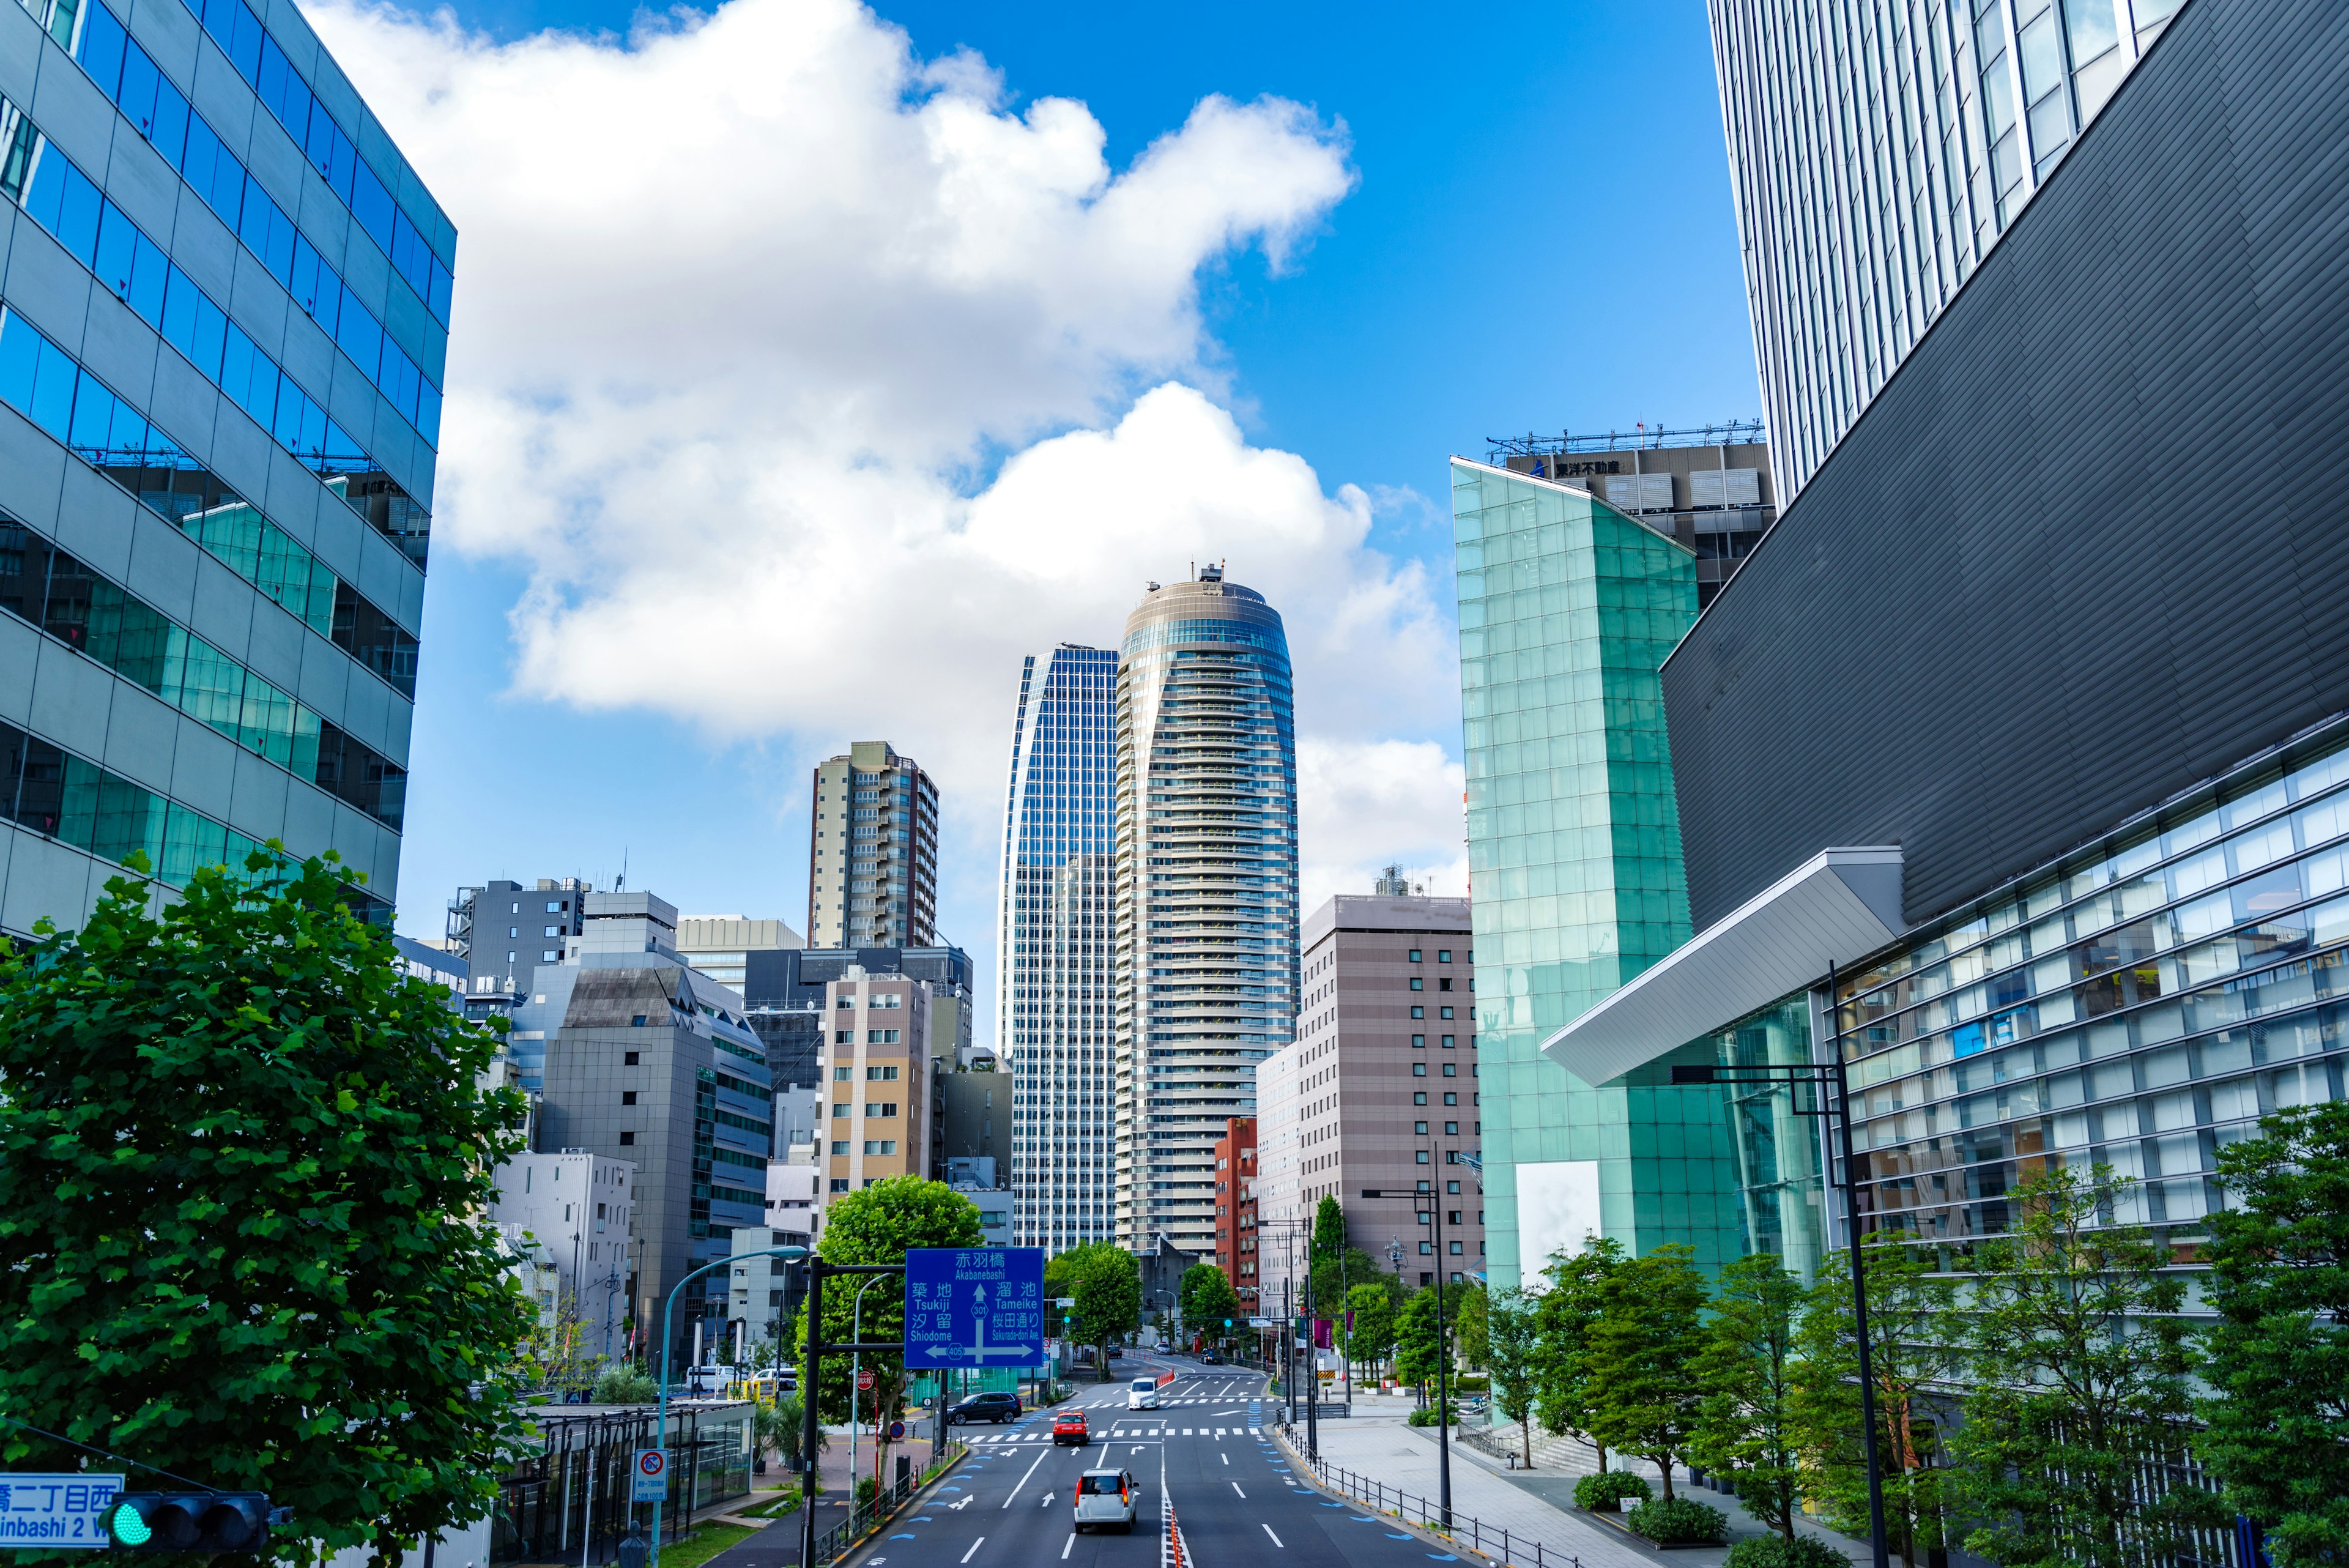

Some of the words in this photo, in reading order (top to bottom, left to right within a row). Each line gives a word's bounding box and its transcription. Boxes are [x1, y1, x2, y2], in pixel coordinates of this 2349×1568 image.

[1556, 461, 1620, 476] 東洋不動産
[956, 1252, 1005, 1268] 赤羽橋
[956, 1269, 1005, 1280] Akabanebashi
[911, 1282, 952, 1298] 築地
[996, 1282, 1036, 1298] 溜池
[915, 1299, 949, 1311] Tsukiji
[995, 1298, 1037, 1309] Tameike
[974, 1306, 986, 1315] 301
[911, 1313, 952, 1329] 汐留
[992, 1313, 1039, 1328] 桜田通り
[911, 1330, 952, 1342] Shiodome
[992, 1330, 1028, 1341] Sakurada-dori
[1030, 1330, 1039, 1340] Ave.
[949, 1348, 962, 1356] 405
[72, 1517, 84, 1537] 2
